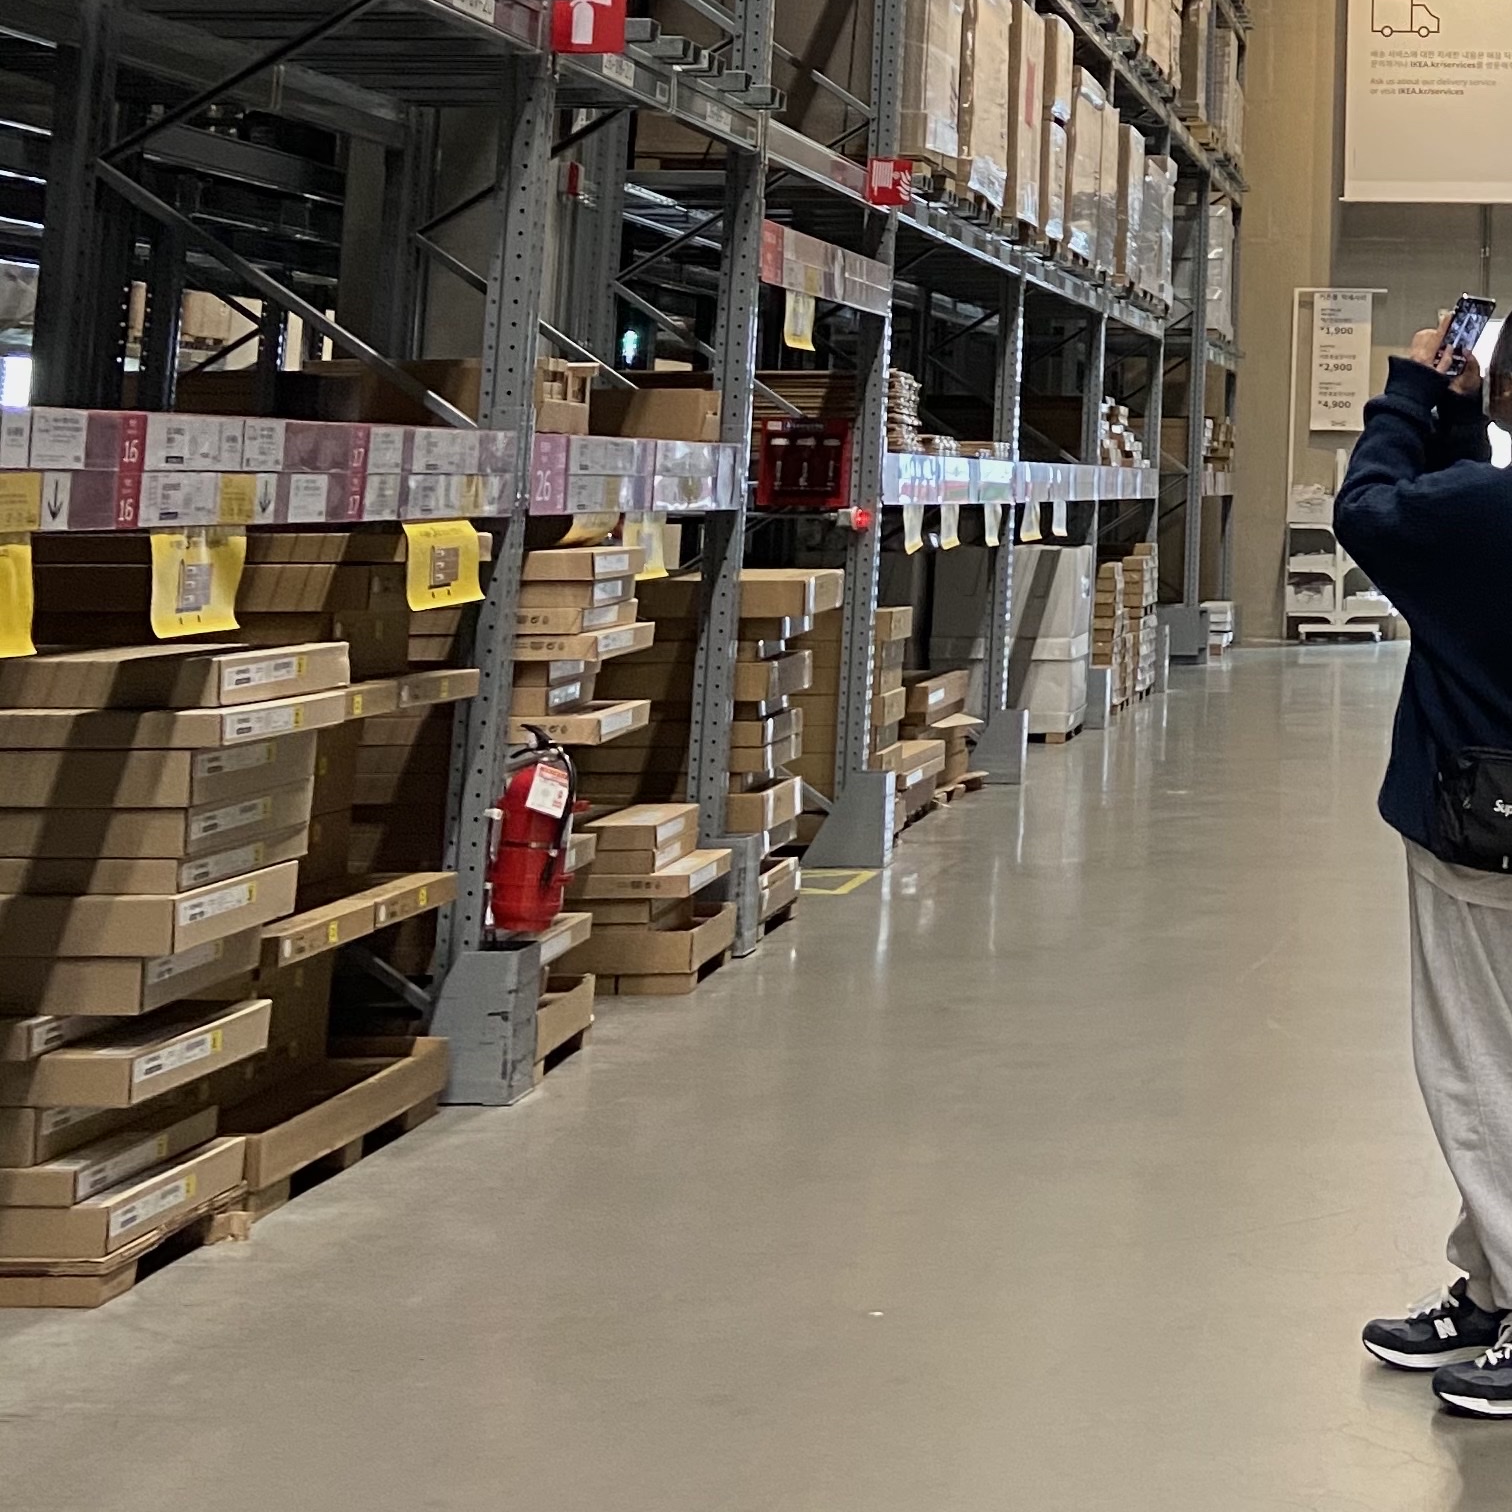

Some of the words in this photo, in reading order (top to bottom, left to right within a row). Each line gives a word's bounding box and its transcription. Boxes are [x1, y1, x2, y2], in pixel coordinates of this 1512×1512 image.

[122, 439, 139, 463] 16
[352, 447, 365, 468] 17
[535, 470, 552, 502] 26
[118, 498, 134, 521] 16
[1433, 1316, 1458, 1339] N
